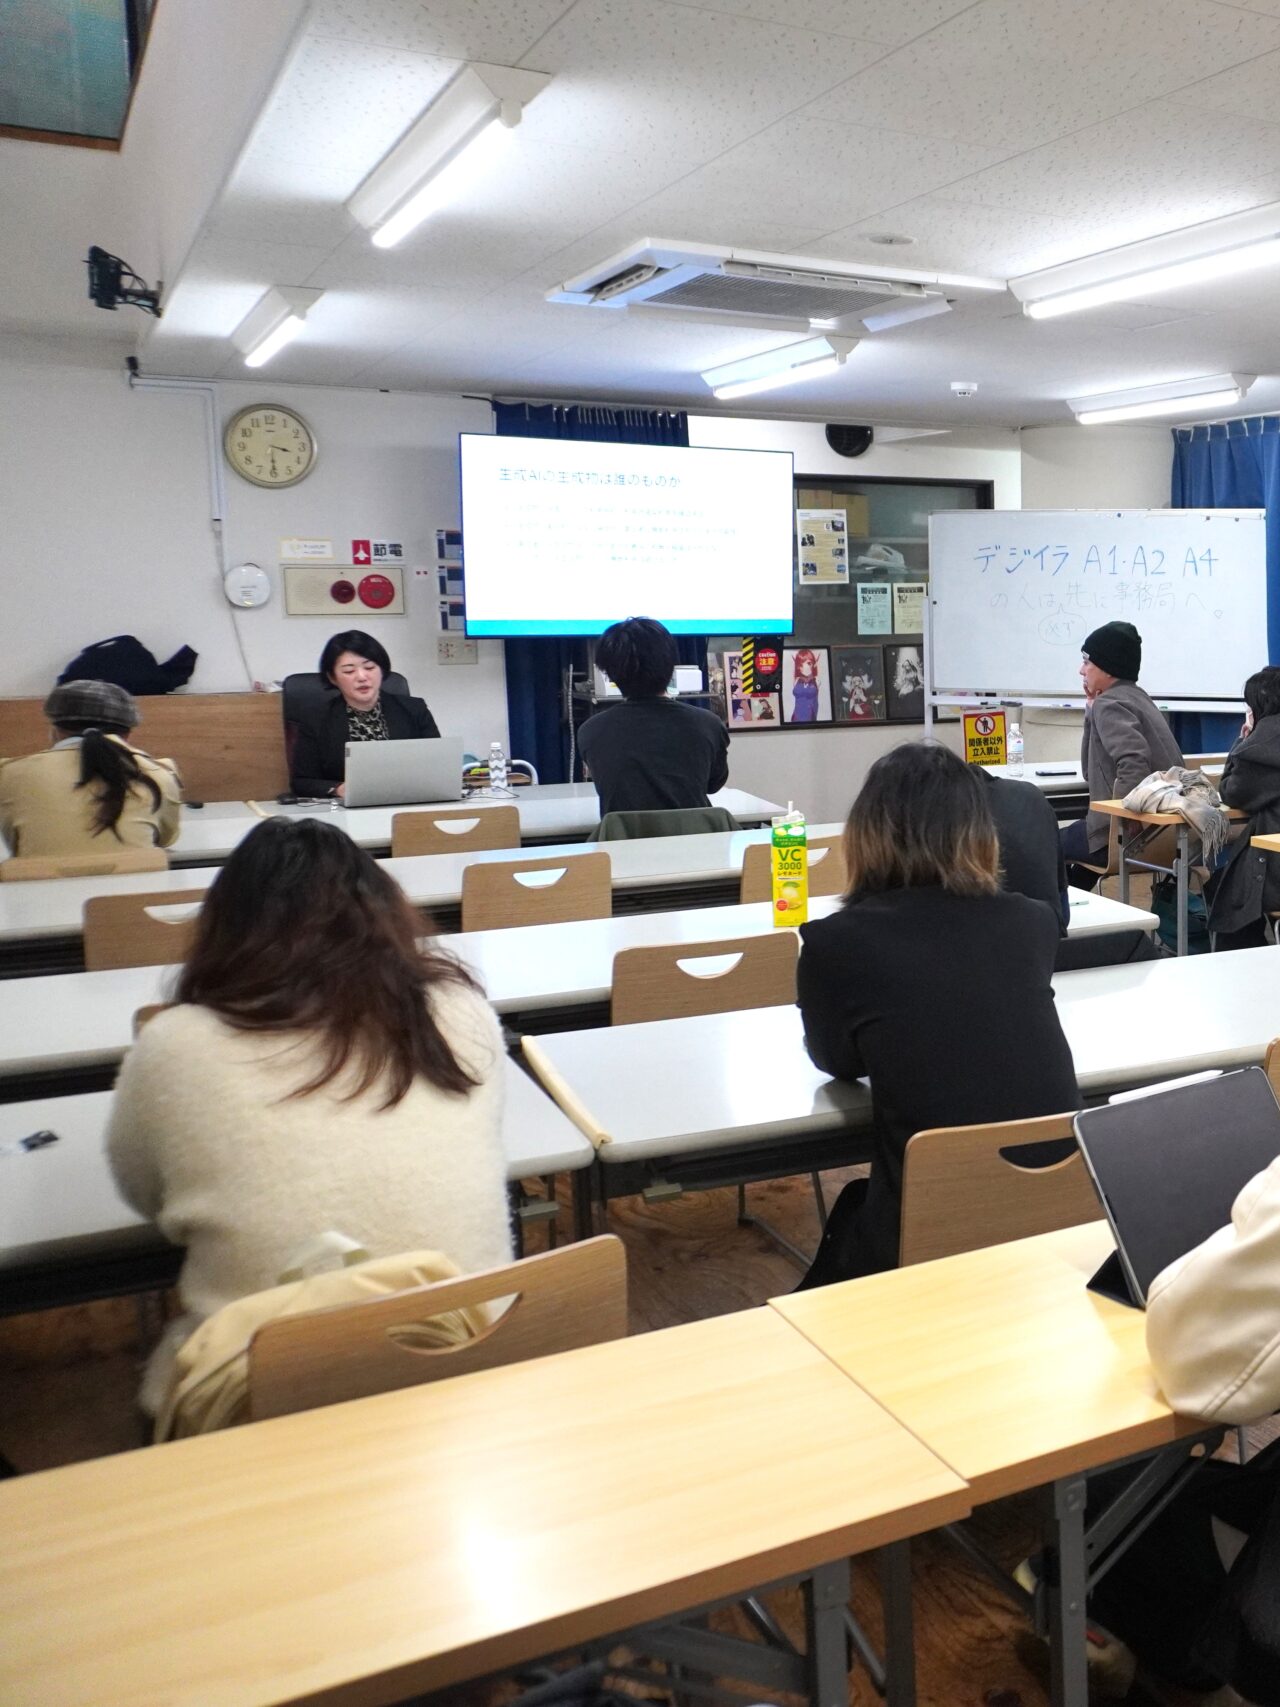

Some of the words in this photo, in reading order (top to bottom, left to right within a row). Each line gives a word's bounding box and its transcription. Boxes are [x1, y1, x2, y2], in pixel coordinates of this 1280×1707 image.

[250, 418, 260, 428] 11
[241, 428, 252, 438] 10
[292, 429, 300, 439] 2
[237, 442, 246, 452] 9
[298, 442, 306, 452] 3
[244, 455, 253, 465] 8
[255, 465, 264, 475] 7
[285, 465, 293, 475] 5
[373, 543, 403, 557] 節電
[973, 544, 1070, 577] デジイラ
[1182, 547, 1220, 577] A4
[968, 736, 1003, 747] 関係者以外
[972, 747, 1000, 757] 立入禁止
[777, 849, 802, 861] VC
[778, 862, 802, 871] 3000
